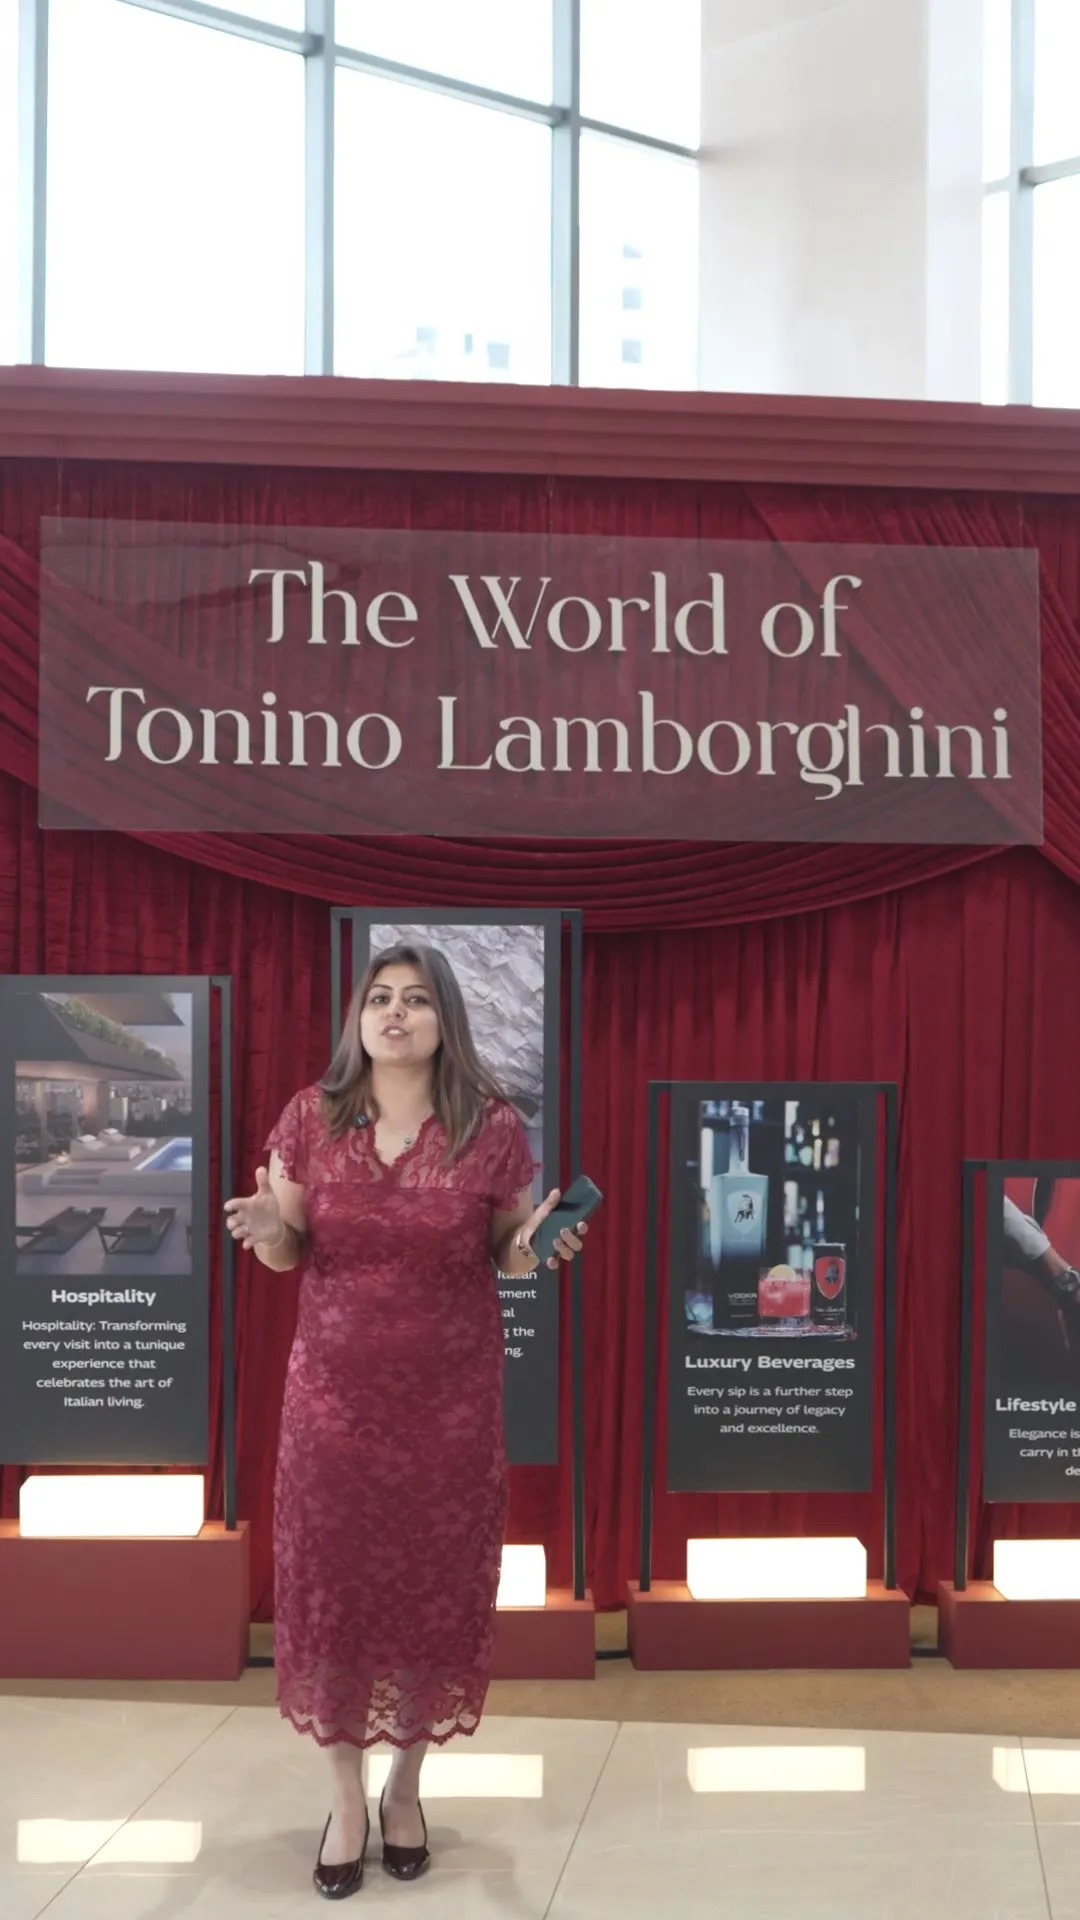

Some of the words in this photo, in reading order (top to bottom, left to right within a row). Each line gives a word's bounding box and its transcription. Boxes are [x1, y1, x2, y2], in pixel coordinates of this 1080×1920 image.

[249, 561, 418, 648] The
[449, 571, 728, 655] World
[760, 575, 862, 657] of
[86, 687, 402, 769] Tonino
[437, 691, 1011, 800] Lamborghini
[51, 1288, 157, 1307] Hospitality
[22, 1319, 96, 1333] Hospitality:
[99, 1319, 187, 1334] Transforming
[512, 1326, 535, 1337] the
[23, 1340, 60, 1352] every
[64, 1339, 90, 1350] visit
[94, 1339, 120, 1350] into
[123, 1341, 132, 1350] a
[135, 1339, 185, 1352] tunique
[52, 1358, 125, 1371] experience
[128, 1358, 157, 1369] that
[684, 1355, 753, 1372] Luxury
[757, 1355, 856, 1373] Beverages
[36, 1377, 105, 1389] celebrates
[109, 1377, 132, 1388] the
[134, 1378, 155, 1389] art
[158, 1377, 174, 1388] of
[687, 1386, 725, 1399] Every
[728, 1386, 747, 1399] sip
[749, 1386, 760, 1397] is
[762, 1388, 772, 1397] a
[774, 1386, 822, 1397] further
[825, 1386, 854, 1399] step
[63, 1396, 104, 1407] Italian
[107, 1396, 145, 1410] living.
[995, 1397, 1077, 1416] Lifestyle
[693, 1404, 720, 1415] into
[722, 1406, 732, 1415] a
[733, 1404, 783, 1417] journey
[785, 1404, 801, 1415] of
[803, 1404, 846, 1417] legacy
[719, 1423, 745, 1434] and
[747, 1423, 820, 1434] excellence.
[1008, 1428, 1068, 1441] Elegance
[1019, 1448, 1055, 1460] carry
[1057, 1447, 1069, 1457] in
